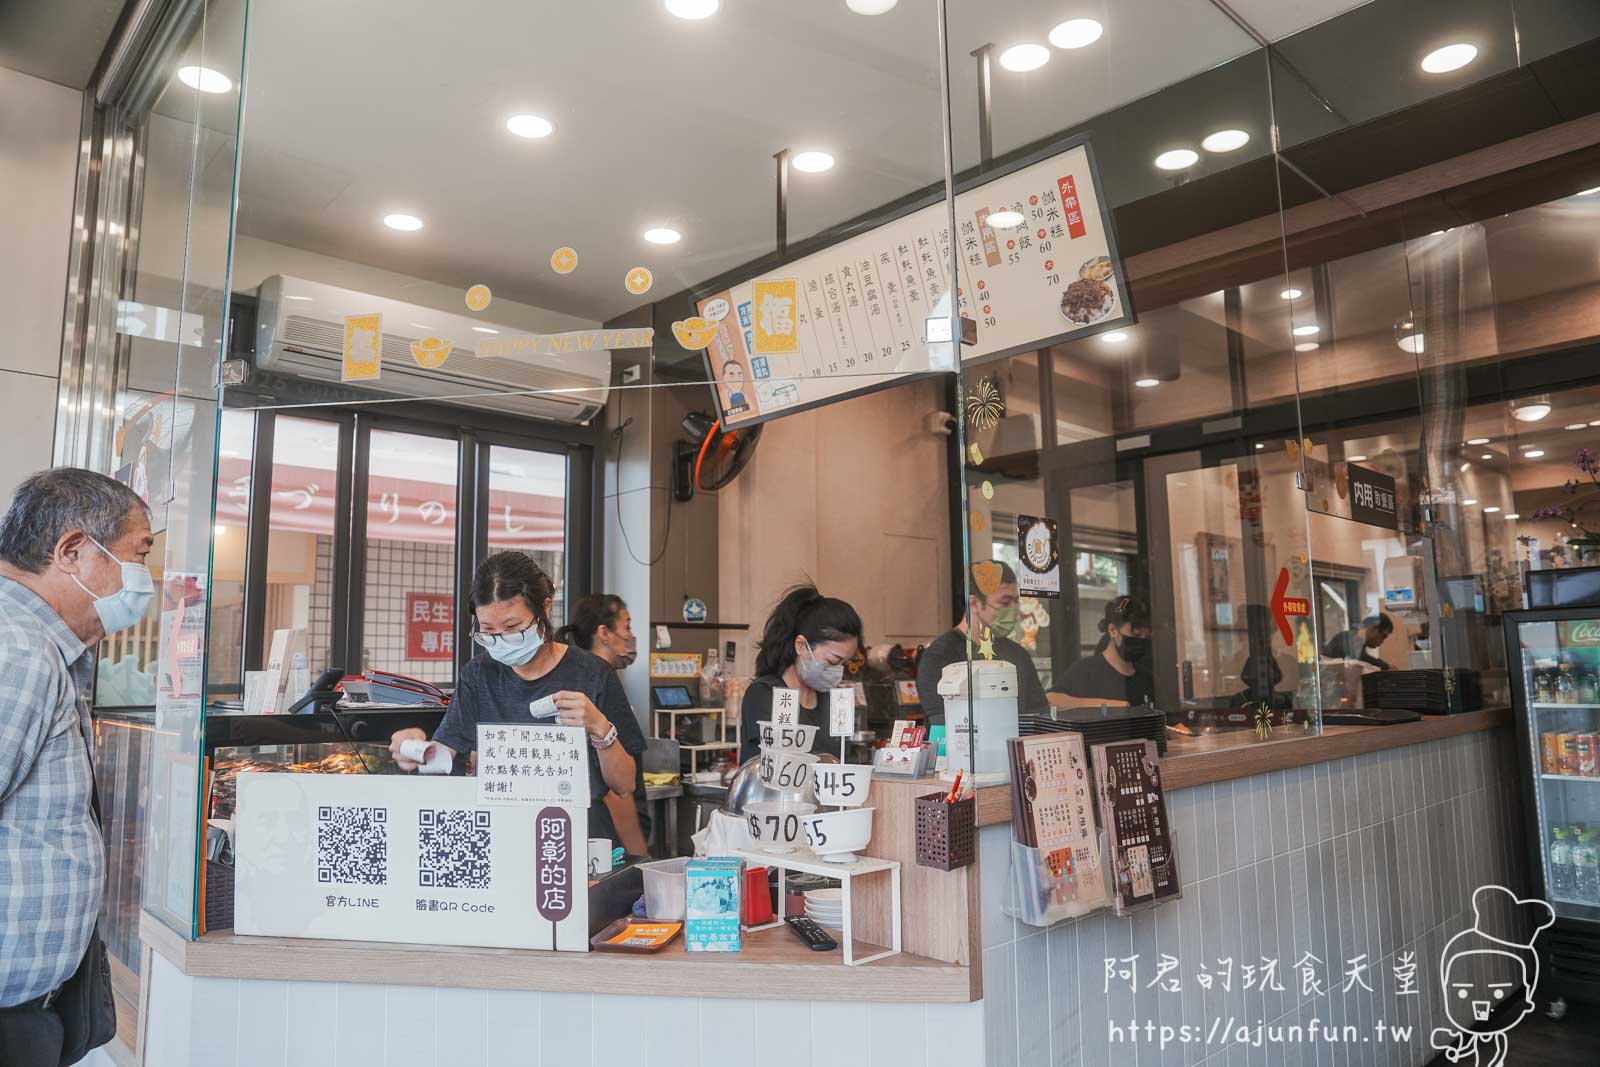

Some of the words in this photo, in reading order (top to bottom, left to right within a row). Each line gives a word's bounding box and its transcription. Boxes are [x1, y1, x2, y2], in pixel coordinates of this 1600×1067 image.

[1061, 182, 1080, 226] 外帶區
[1031, 207, 1044, 221] 50
[1042, 189, 1065, 240] 鹹米糕
[1039, 240, 1052, 253] 60
[1008, 252, 1020, 265] 55
[841, 265, 858, 308] 貢丸湯
[1046, 273, 1059, 287] 70
[859, 259, 880, 316] 油豆腐湯
[978, 291, 990, 302] 40
[984, 316, 996, 328] 50
[478, 337, 544, 354] HAPPY
[549, 335, 598, 353] NEW
[601, 330, 653, 350] YEAR
[901, 340, 911, 352] 25
[863, 352, 873, 363] 20
[882, 346, 892, 357] 20
[828, 362, 838, 373] 15
[845, 357, 855, 368] 20
[812, 367, 822, 378] 10
[412, 600, 454, 623] 民生
[778, 692, 793, 727] 米糕
[484, 729, 575, 746] 如需「開立統編」
[761, 725, 806, 750] $50
[484, 764, 574, 778] 於點餐前先告知!
[761, 753, 807, 789] $60
[484, 781, 513, 794] 謝謝!
[747, 814, 799, 843] $70
[540, 818, 567, 910] 阿彰的店
[326, 895, 380, 908] 官方LINE
[415, 898, 458, 912] 臉書QR
[461, 902, 496, 914] Code
